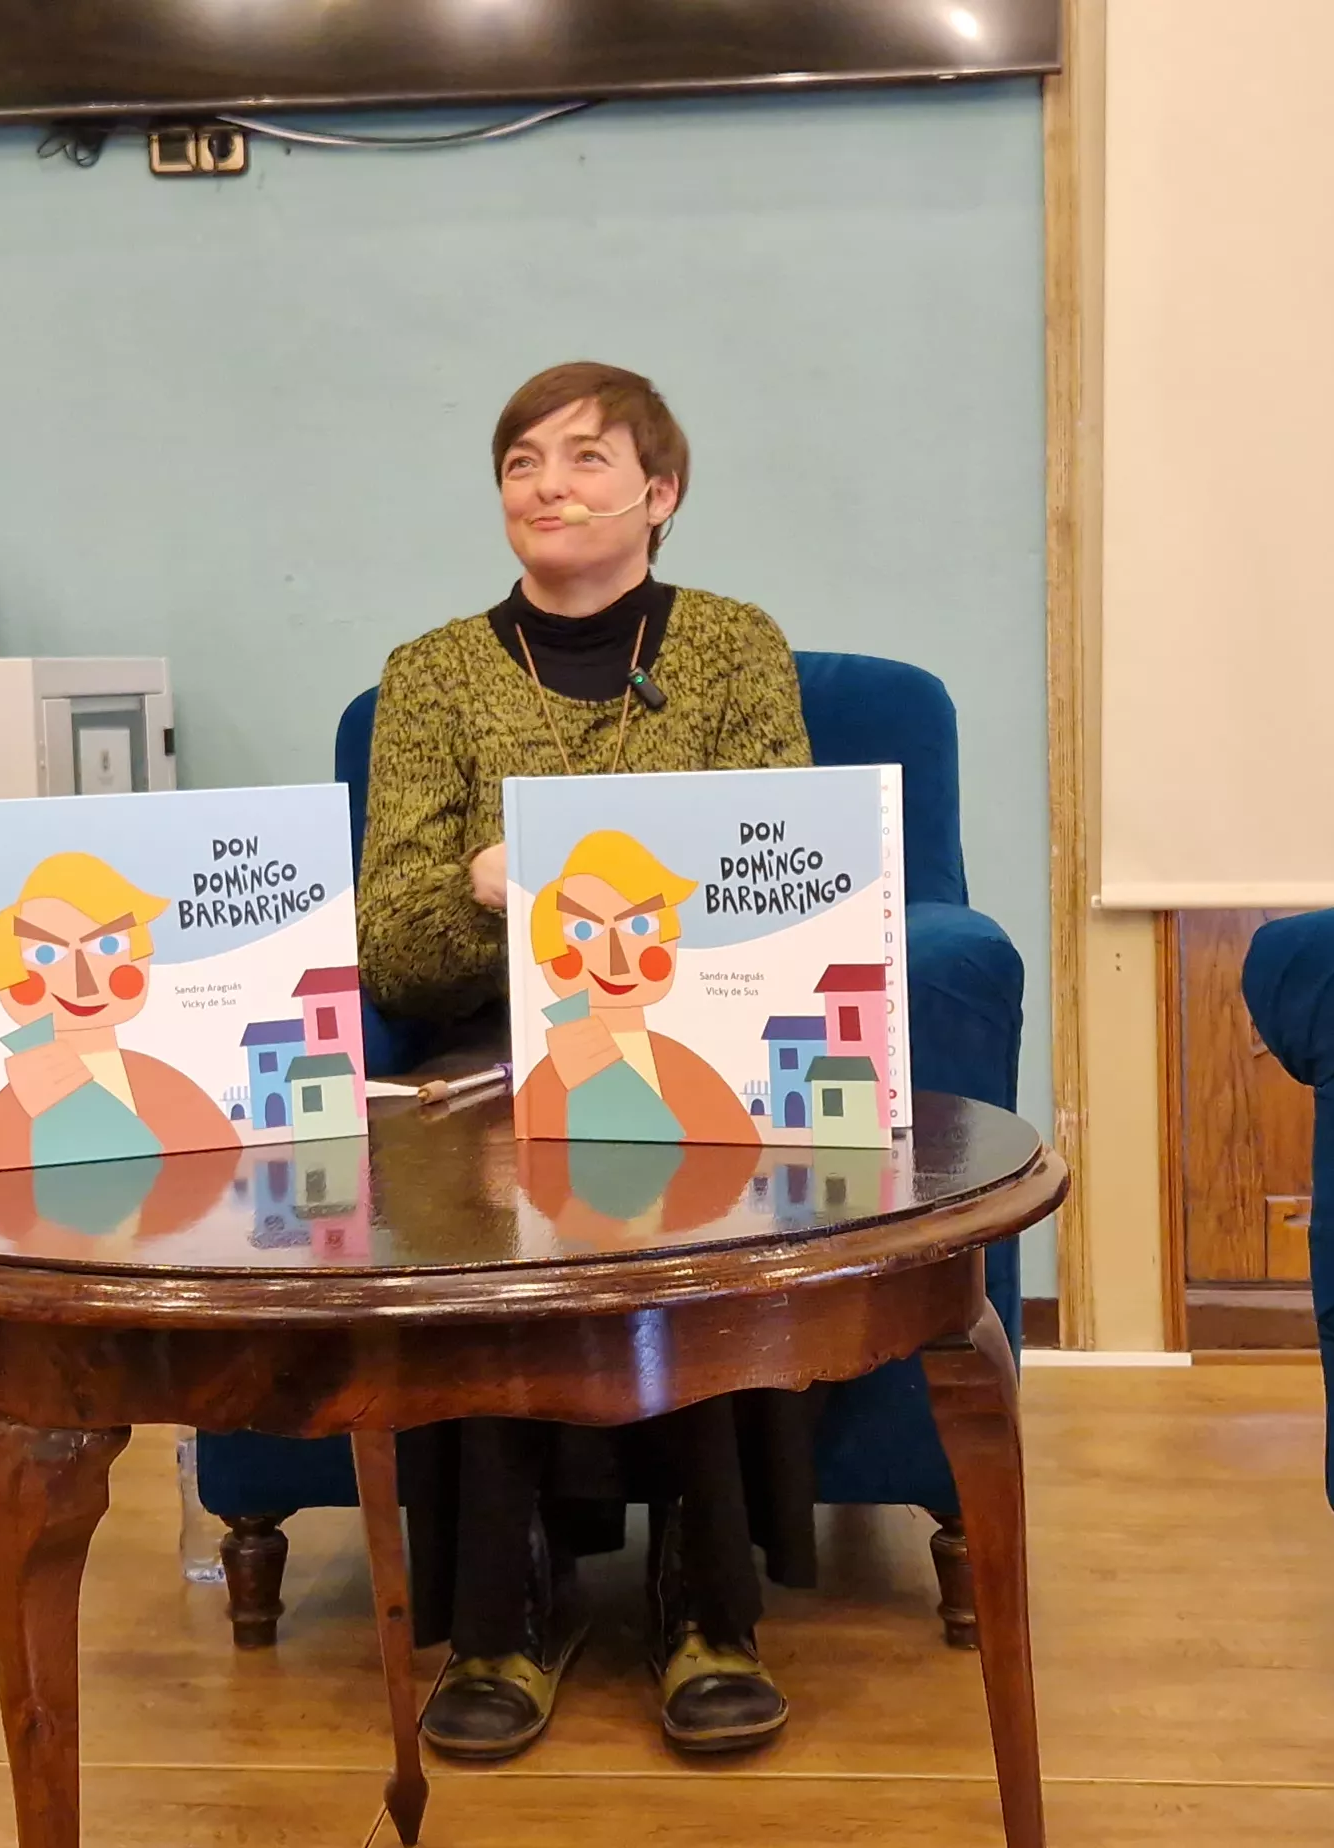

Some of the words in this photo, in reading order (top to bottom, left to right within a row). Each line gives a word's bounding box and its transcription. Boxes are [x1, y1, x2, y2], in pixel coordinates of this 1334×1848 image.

[740, 820, 785, 846] DON
[212, 835, 258, 861] DON
[699, 971, 729, 981] Sandra
[730, 971, 765, 983] Araguás
[174, 984, 205, 995] Sandra
[207, 982, 242, 994] Araguás
[705, 986, 728, 998] Vicky
[730, 987, 742, 996] de
[743, 986, 759, 996] Sus
[181, 999, 206, 1010] Vicky
[207, 998, 219, 1007] de
[221, 997, 237, 1006] Sus
